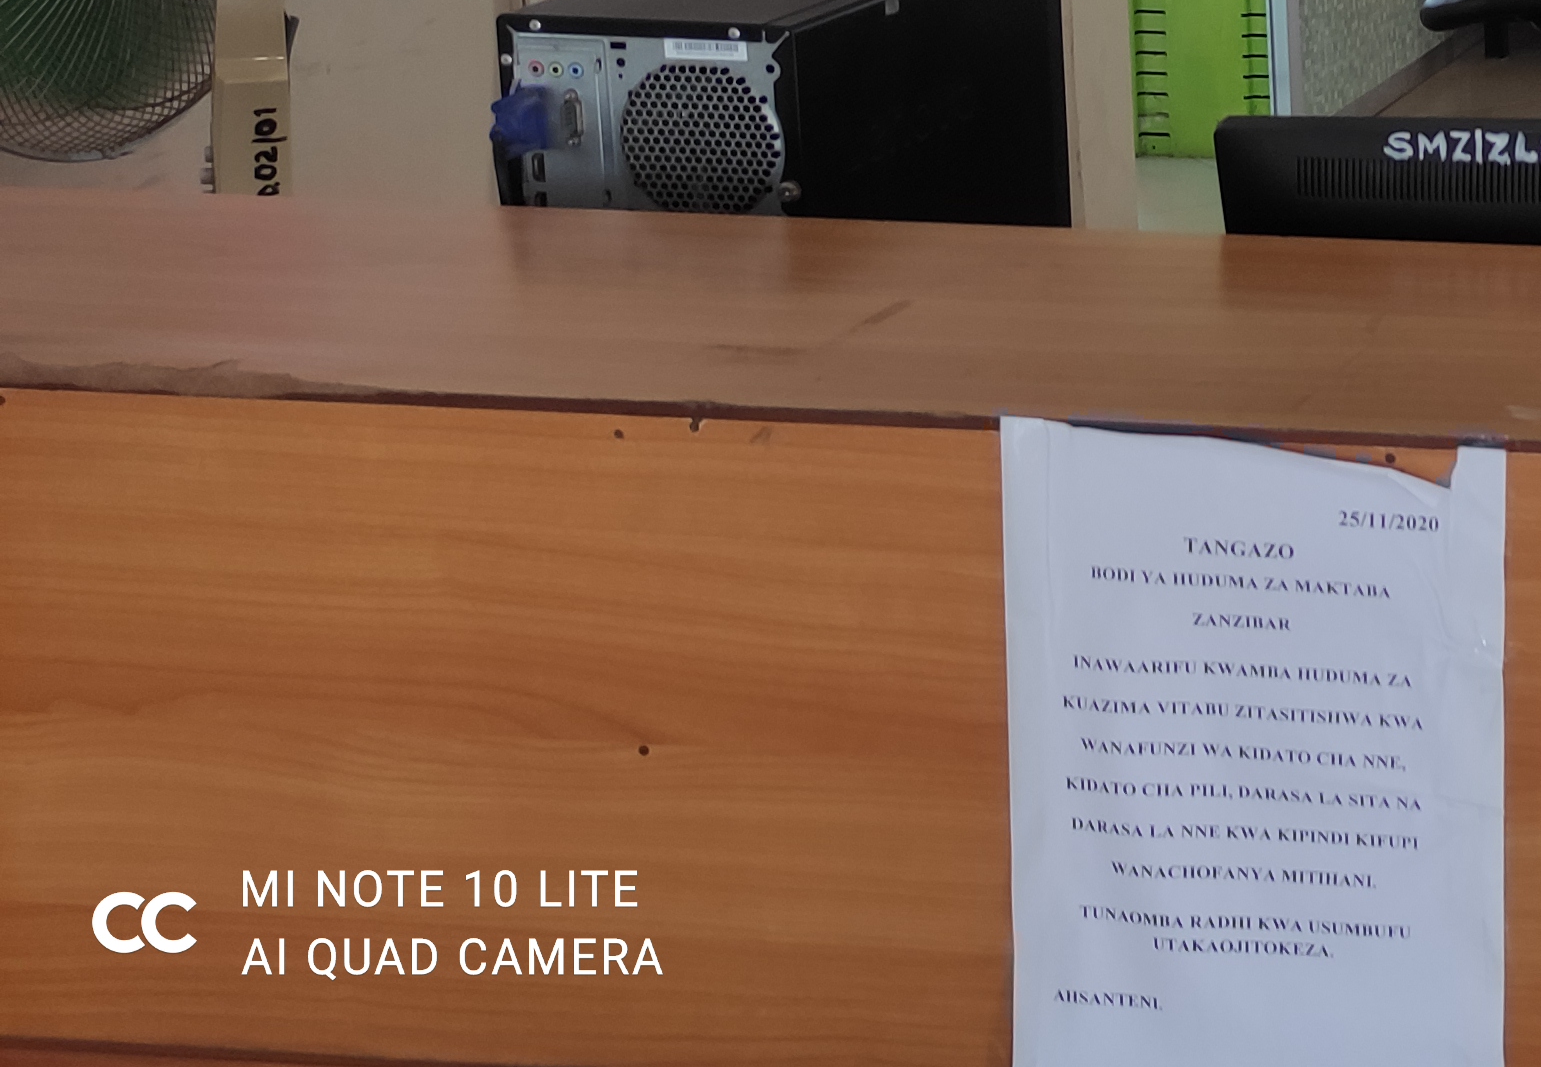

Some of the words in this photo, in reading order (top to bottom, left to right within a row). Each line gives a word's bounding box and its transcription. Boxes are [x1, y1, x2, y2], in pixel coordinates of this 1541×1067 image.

[1338, 510, 1440, 532] 25/11/2020
[1183, 537, 1295, 560] TANGAZO
[1091, 565, 1135, 583] BODI
[1141, 569, 1167, 585] YA
[1173, 571, 1259, 591] HUDUMA
[1264, 577, 1290, 592] ZA
[1294, 579, 1391, 599] MAKTABA
[1192, 612, 1291, 631] ZANZIBAR
[1073, 654, 1197, 675] INAWAARIFU
[1204, 661, 1292, 680] KWAMBA
[1298, 666, 1382, 687] HUDUMA
[1387, 673, 1412, 688] ZA
[1062, 695, 1151, 715] KUAZIMA
[1157, 700, 1230, 717] VITABU
[1235, 704, 1373, 727] ZITASITISHWA
[1379, 713, 1424, 731] KWA
[1080, 736, 1196, 756] WANAFUNZI
[1202, 742, 1233, 759] WA
[1239, 745, 1312, 767] KIDATO
[1315, 751, 1357, 768] CHA
[1363, 753, 1407, 773] NNE,
[1066, 776, 1137, 796] KIDATO
[1141, 782, 1184, 798] CHA
[1190, 783, 1234, 801] PILI,
[1238, 785, 1313, 804] DARASA
[1319, 791, 1343, 806] LA
[1348, 794, 1391, 809] SITA
[1396, 796, 1423, 811] NA
[1071, 817, 1144, 838] DARASA
[1149, 823, 1175, 839] LA
[1181, 824, 1221, 840] NNE
[1226, 825, 1272, 841] KWA
[1278, 827, 1350, 846] KIPINDI
[1356, 833, 1419, 851] KIFUPI
[1111, 860, 1276, 883] WANACHOFANYA
[1281, 868, 1378, 890] MITIHANI.
[1079, 905, 1185, 929] TUNAOMBA
[1190, 915, 1252, 931] RADHI
[1258, 917, 1304, 933] KWA
[1308, 919, 1411, 940] USUMBUFU
[1153, 936, 1335, 959] UTAKAOJITOKEZA.
[1053, 989, 1164, 1011] AHSANTENI.
